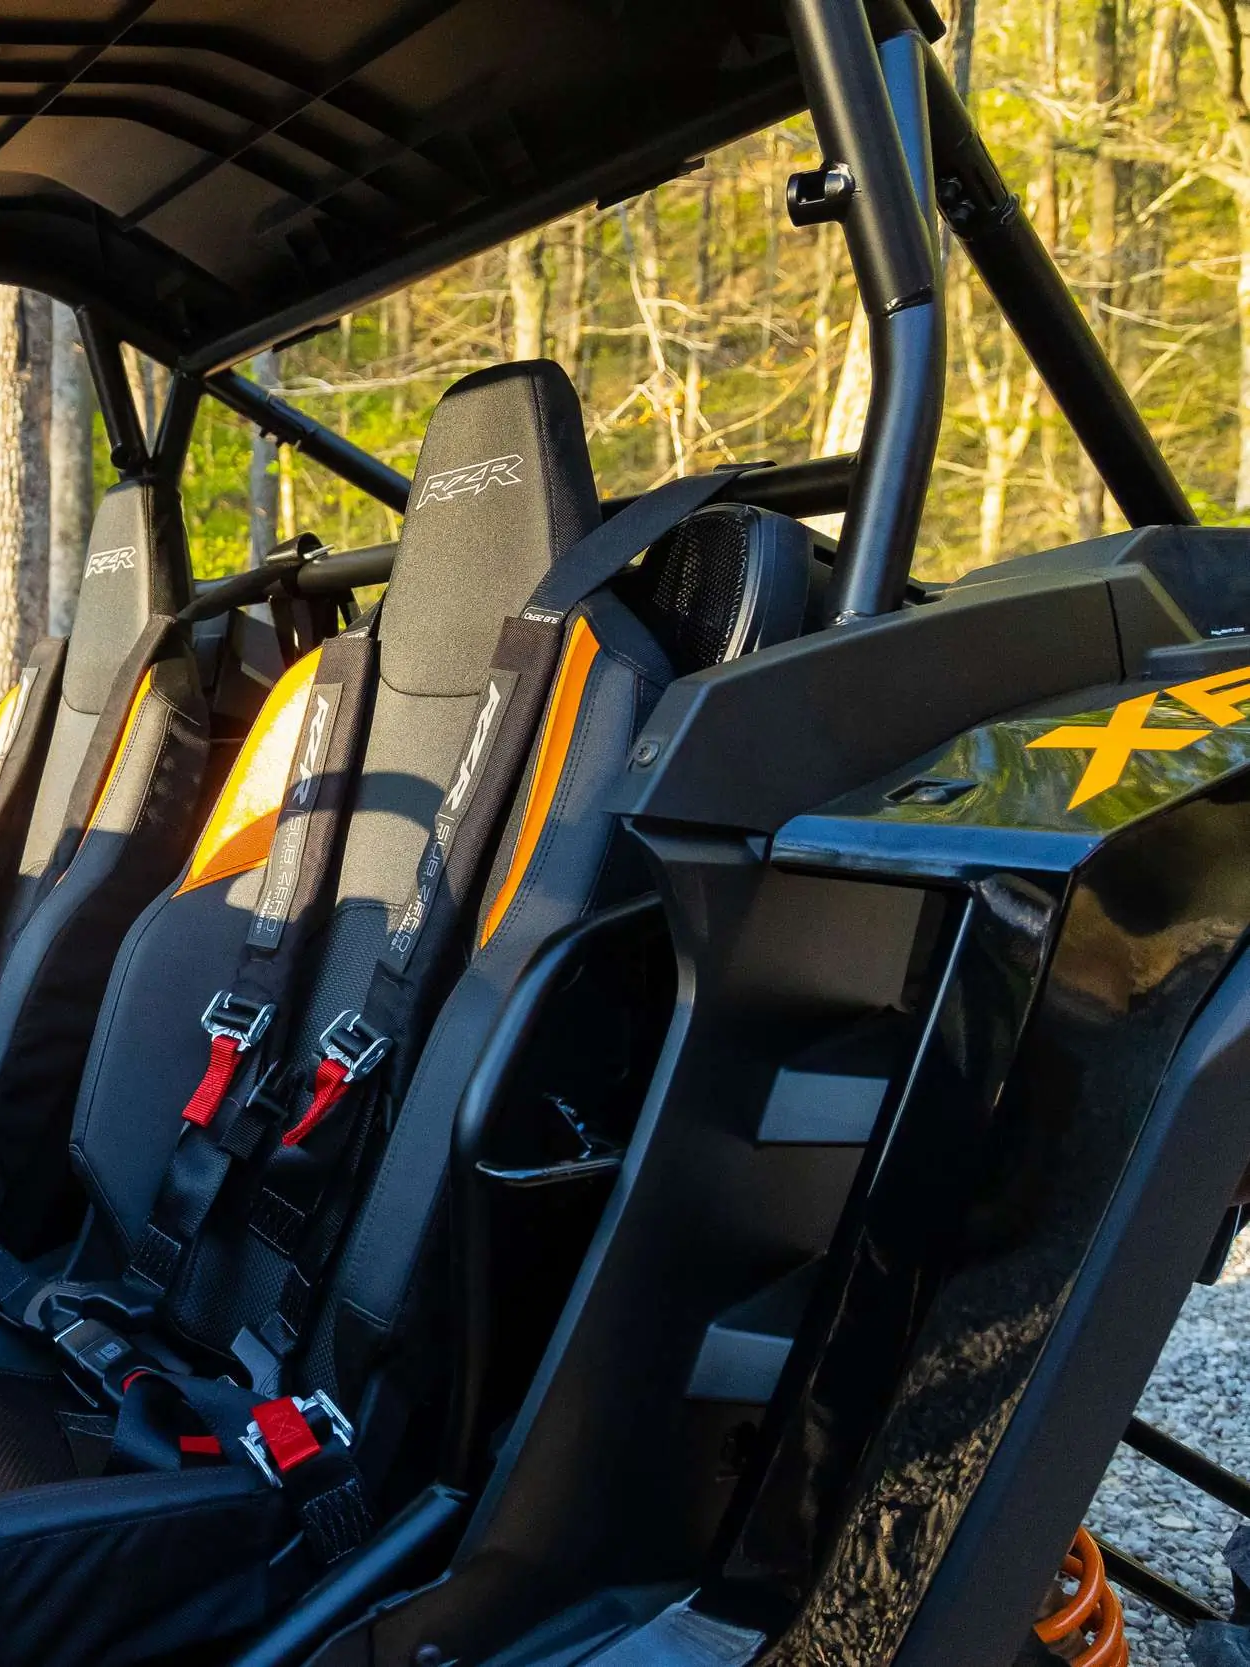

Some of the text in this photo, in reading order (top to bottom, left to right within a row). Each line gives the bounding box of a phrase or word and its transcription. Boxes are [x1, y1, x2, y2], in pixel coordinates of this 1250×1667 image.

[416, 454, 524, 510] RZR
[84, 546, 136, 579] RZR
[292, 694, 329, 805] RZR
[445, 681, 500, 811] RZR
[283, 816, 302, 865] SUB
[426, 822, 450, 877] SUB
[265, 869, 295, 932] ZERO
